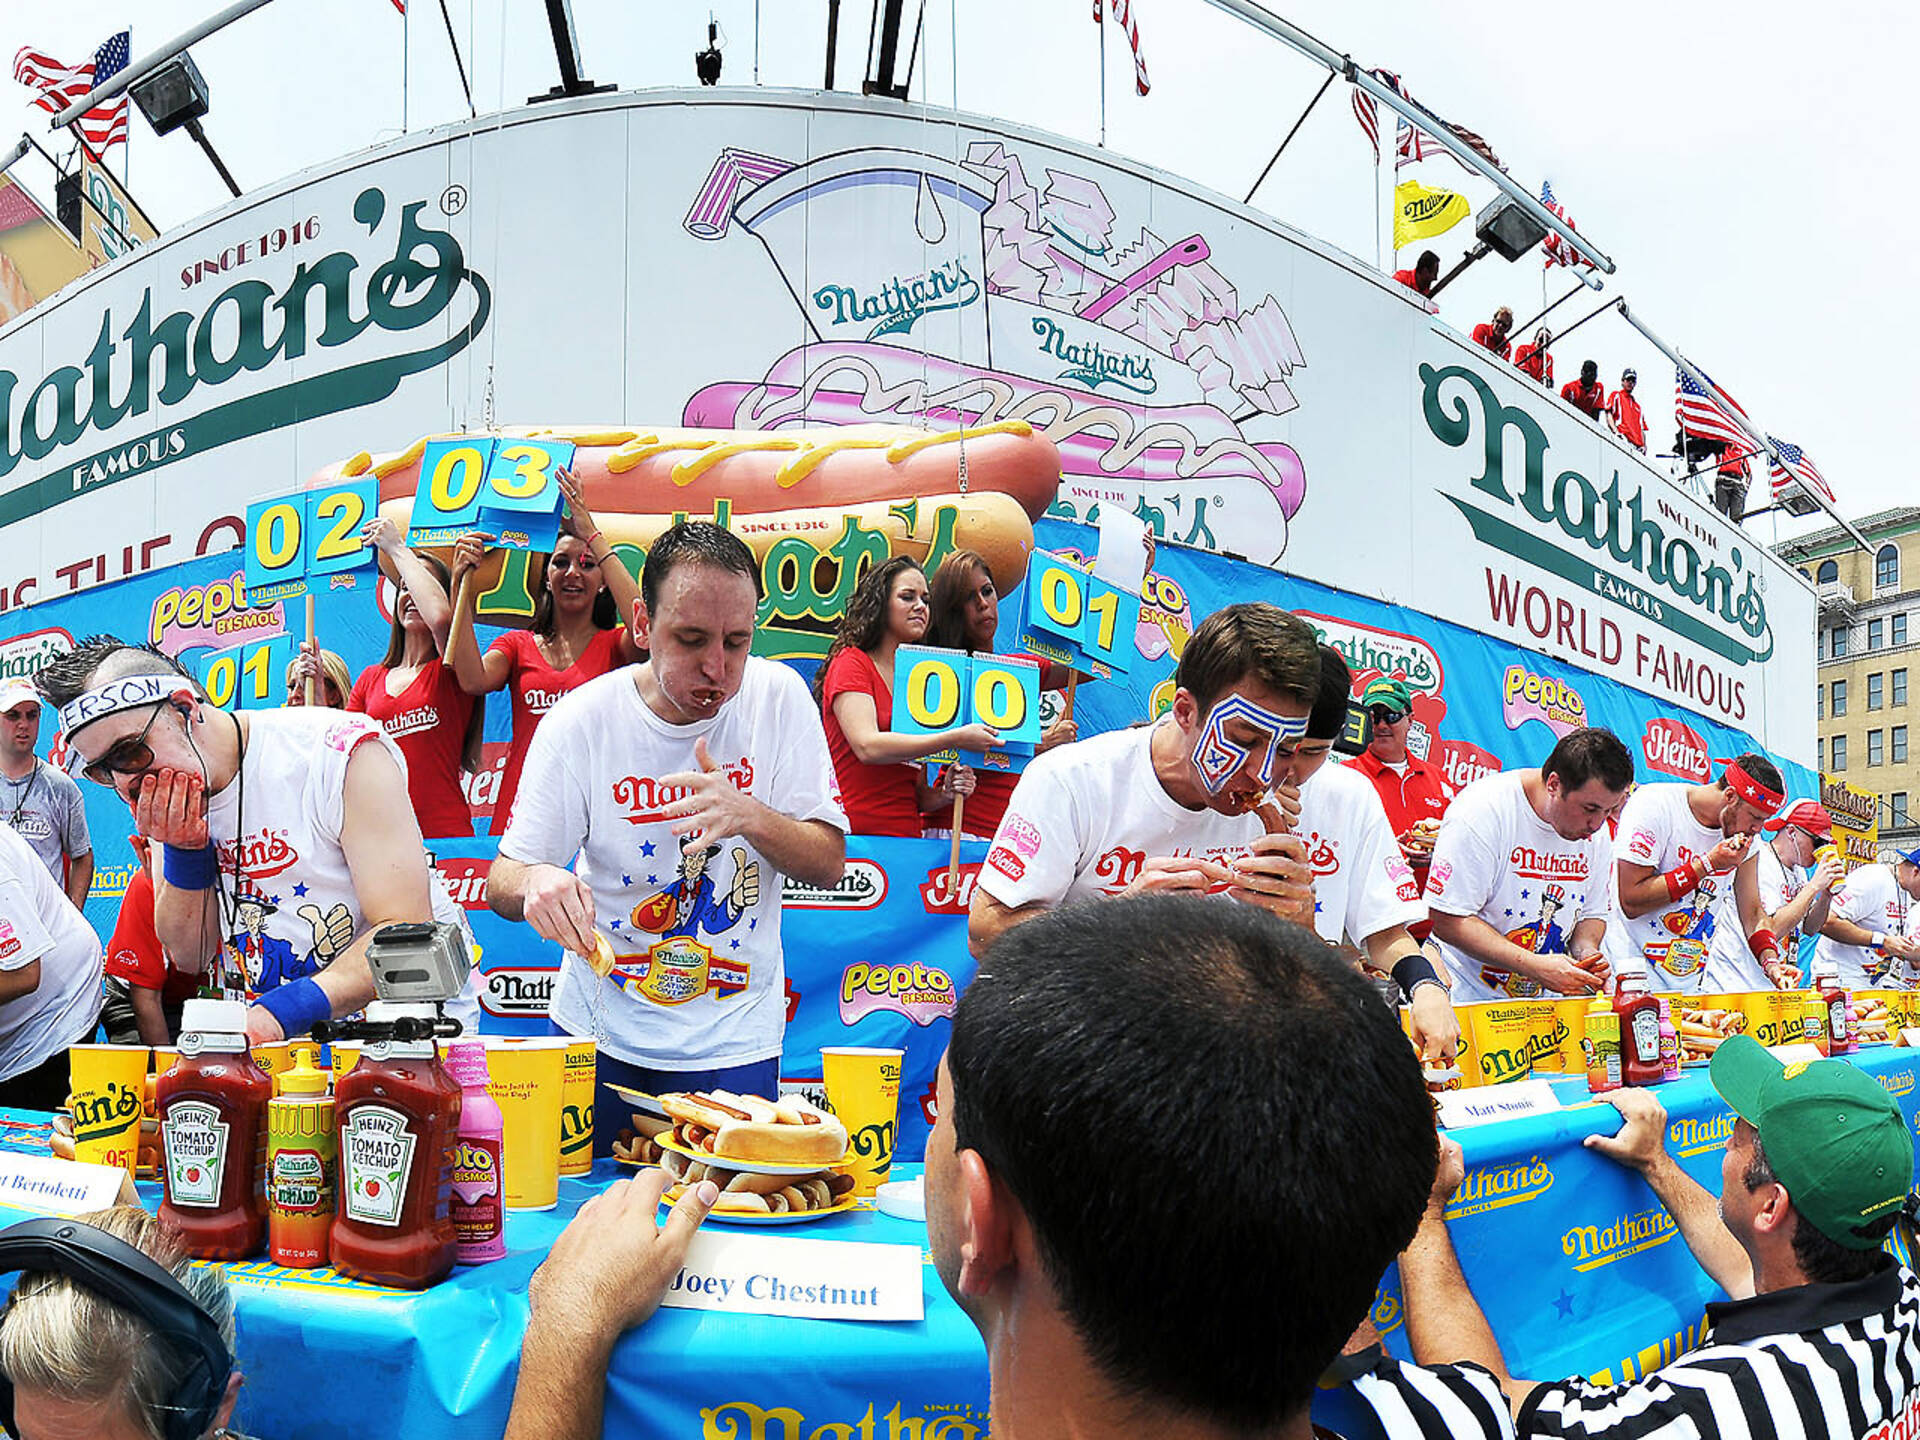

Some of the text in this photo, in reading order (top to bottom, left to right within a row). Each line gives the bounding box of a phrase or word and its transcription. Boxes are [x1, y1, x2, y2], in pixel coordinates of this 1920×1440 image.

[180, 214, 322, 290] SINCE 1916
[812, 257, 971, 326] Nathan's
[1031, 316, 1156, 381] Nathan's
[71, 428, 187, 492] FAMOUS
[1418, 361, 1768, 638] Nathan's
[1656, 498, 1691, 532] SINCE
[740, 520, 830, 534] SINCE 1916
[1593, 570, 1664, 622] FAMOUS
[215, 612, 279, 636] BISMOL
[1484, 566, 1745, 721] WORLD FAMOUS
[1505, 667, 1583, 714] Pepto
[1645, 724, 1710, 777] Heinz
[1511, 846, 1589, 875] Nathan's
[844, 961, 951, 1001] Pepto
[901, 991, 953, 1005] BISMOL
[176, 1111, 211, 1126] HEINZ
[357, 1117, 395, 1134] HEINZ
[170, 1130, 218, 1147] TOMATO
[173, 1144, 216, 1157] KETCHUP
[350, 1137, 403, 1157] TOMATO
[351, 1152, 399, 1169] KETCHUP
[11, 1174, 90, 1201] Bertoletti
[670, 1265, 882, 1307] Joey Chestnut
